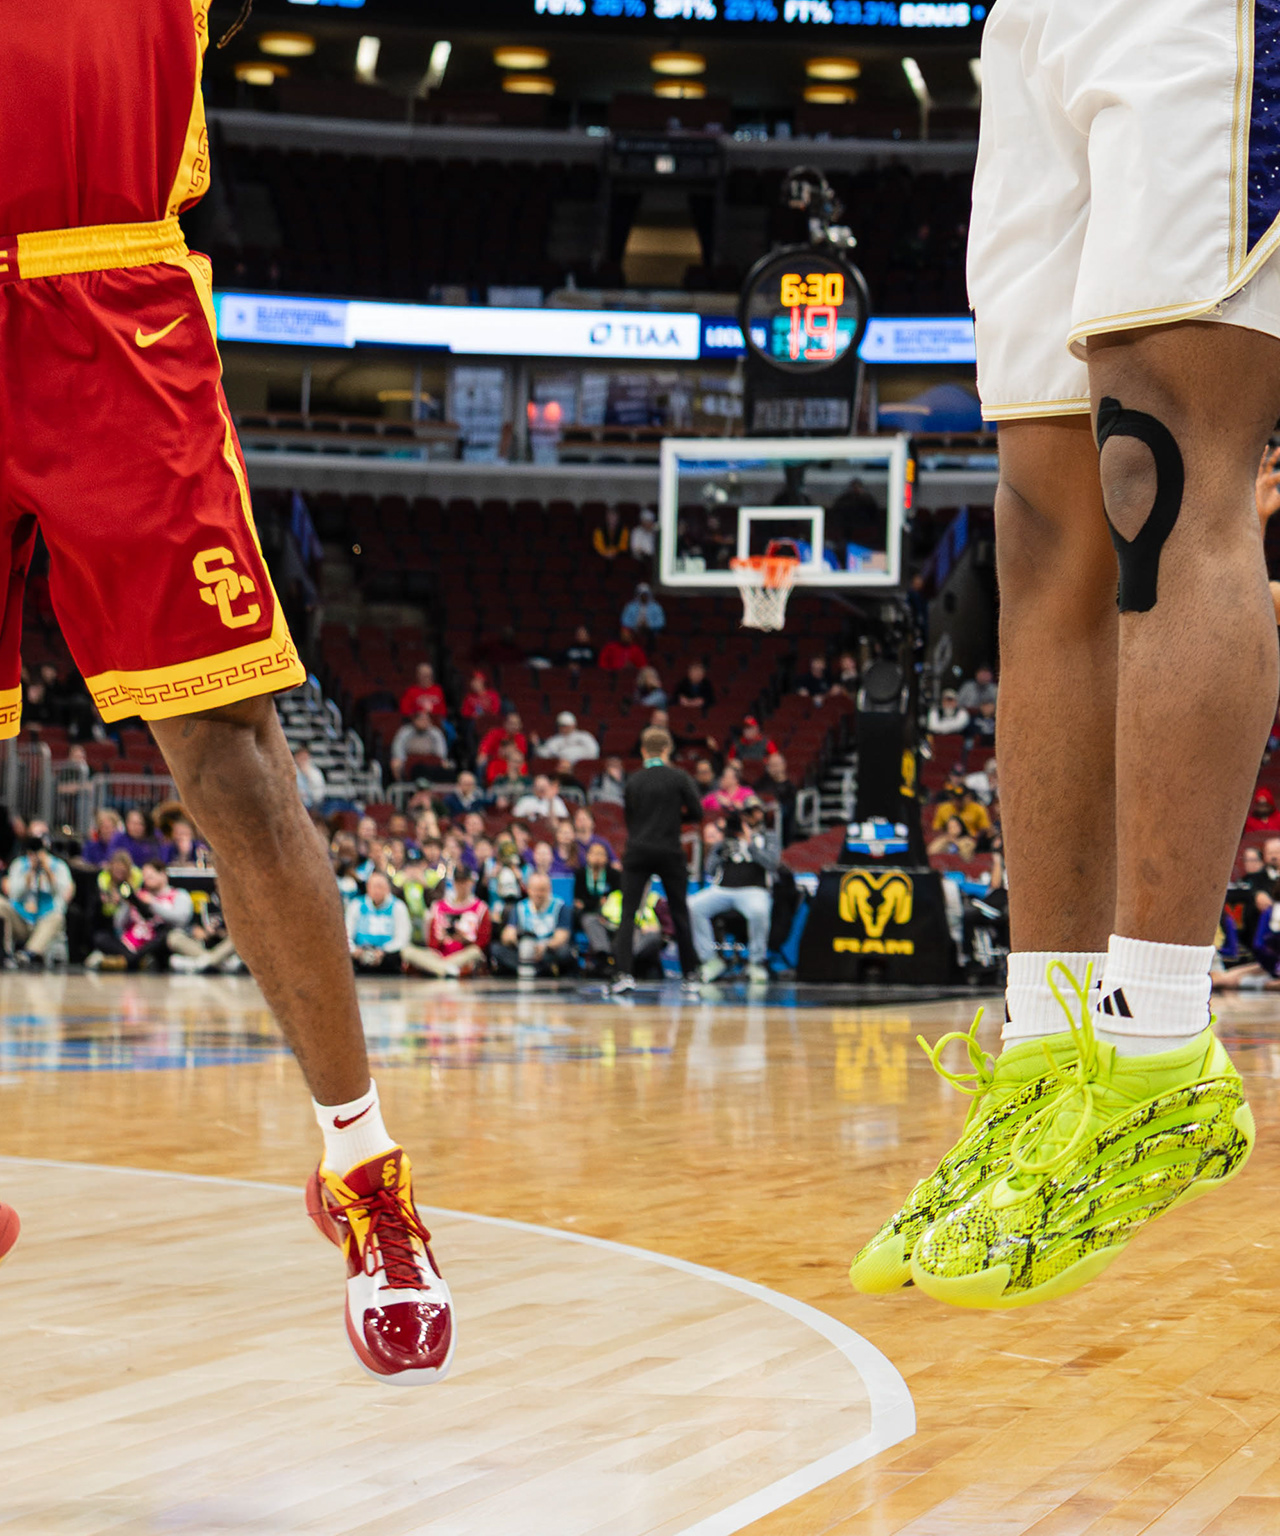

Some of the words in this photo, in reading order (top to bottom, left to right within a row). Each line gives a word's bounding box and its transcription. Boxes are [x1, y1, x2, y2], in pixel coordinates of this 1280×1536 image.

[780, 272, 845, 308] 6:30
[622, 323, 682, 347] TIAA
[790, 304, 839, 361] 19
[191, 545, 262, 631] SC
[831, 936, 916, 956] RAM
[381, 1158, 400, 1188] SC
